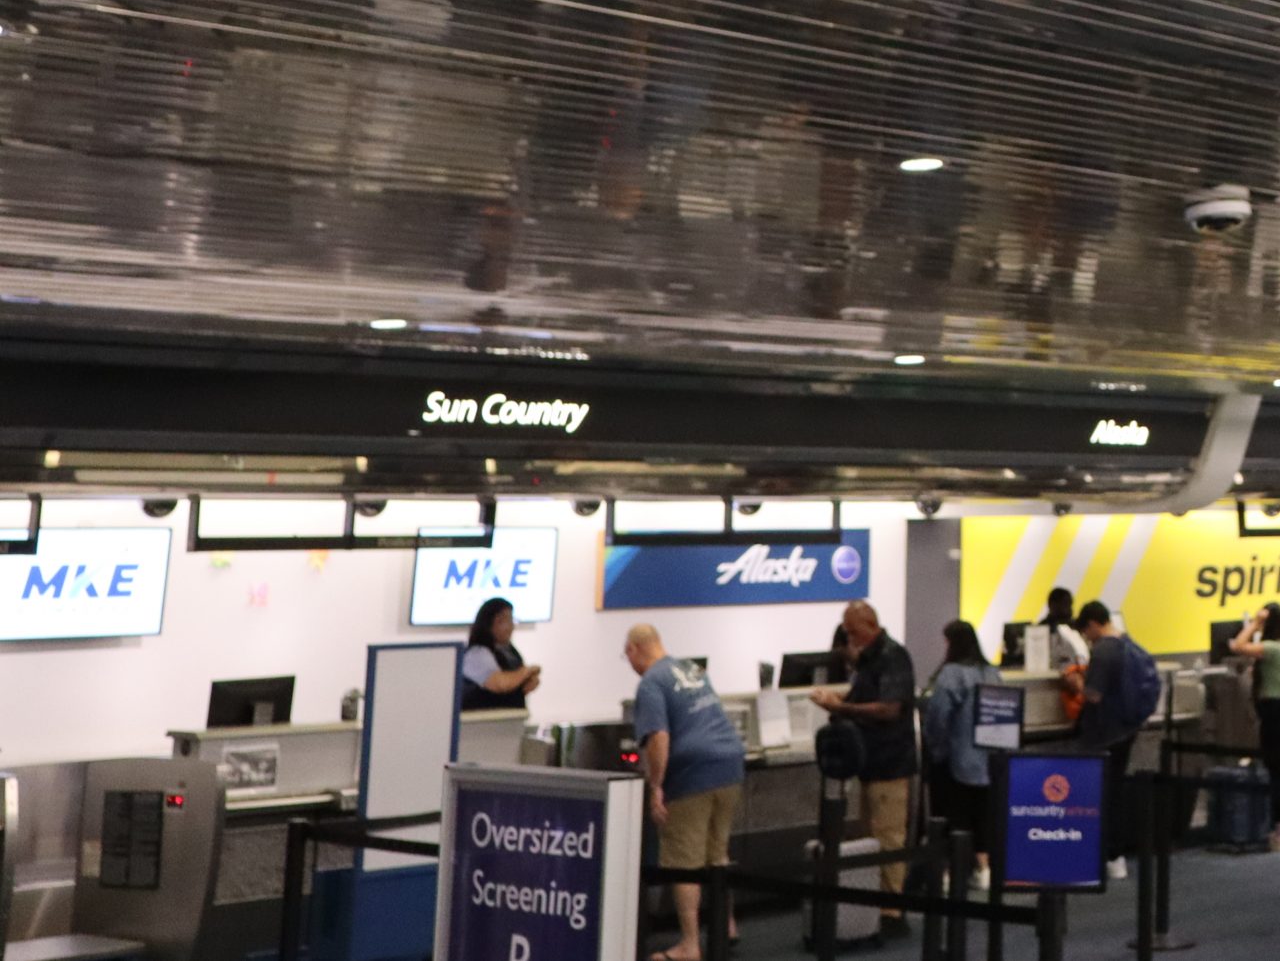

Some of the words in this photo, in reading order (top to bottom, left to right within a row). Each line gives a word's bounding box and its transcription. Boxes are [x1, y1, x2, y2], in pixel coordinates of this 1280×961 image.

[422, 391, 478, 423] Sun
[481, 393, 590, 434] Country
[1089, 419, 1150, 446] Alaska
[21, 564, 140, 600] MKE
[442, 558, 533, 588] MKE
[715, 543, 818, 588] Alaska
[471, 812, 595, 859] Oversized
[1027, 827, 1083, 841] Check-in
[472, 869, 588, 930] Screening
